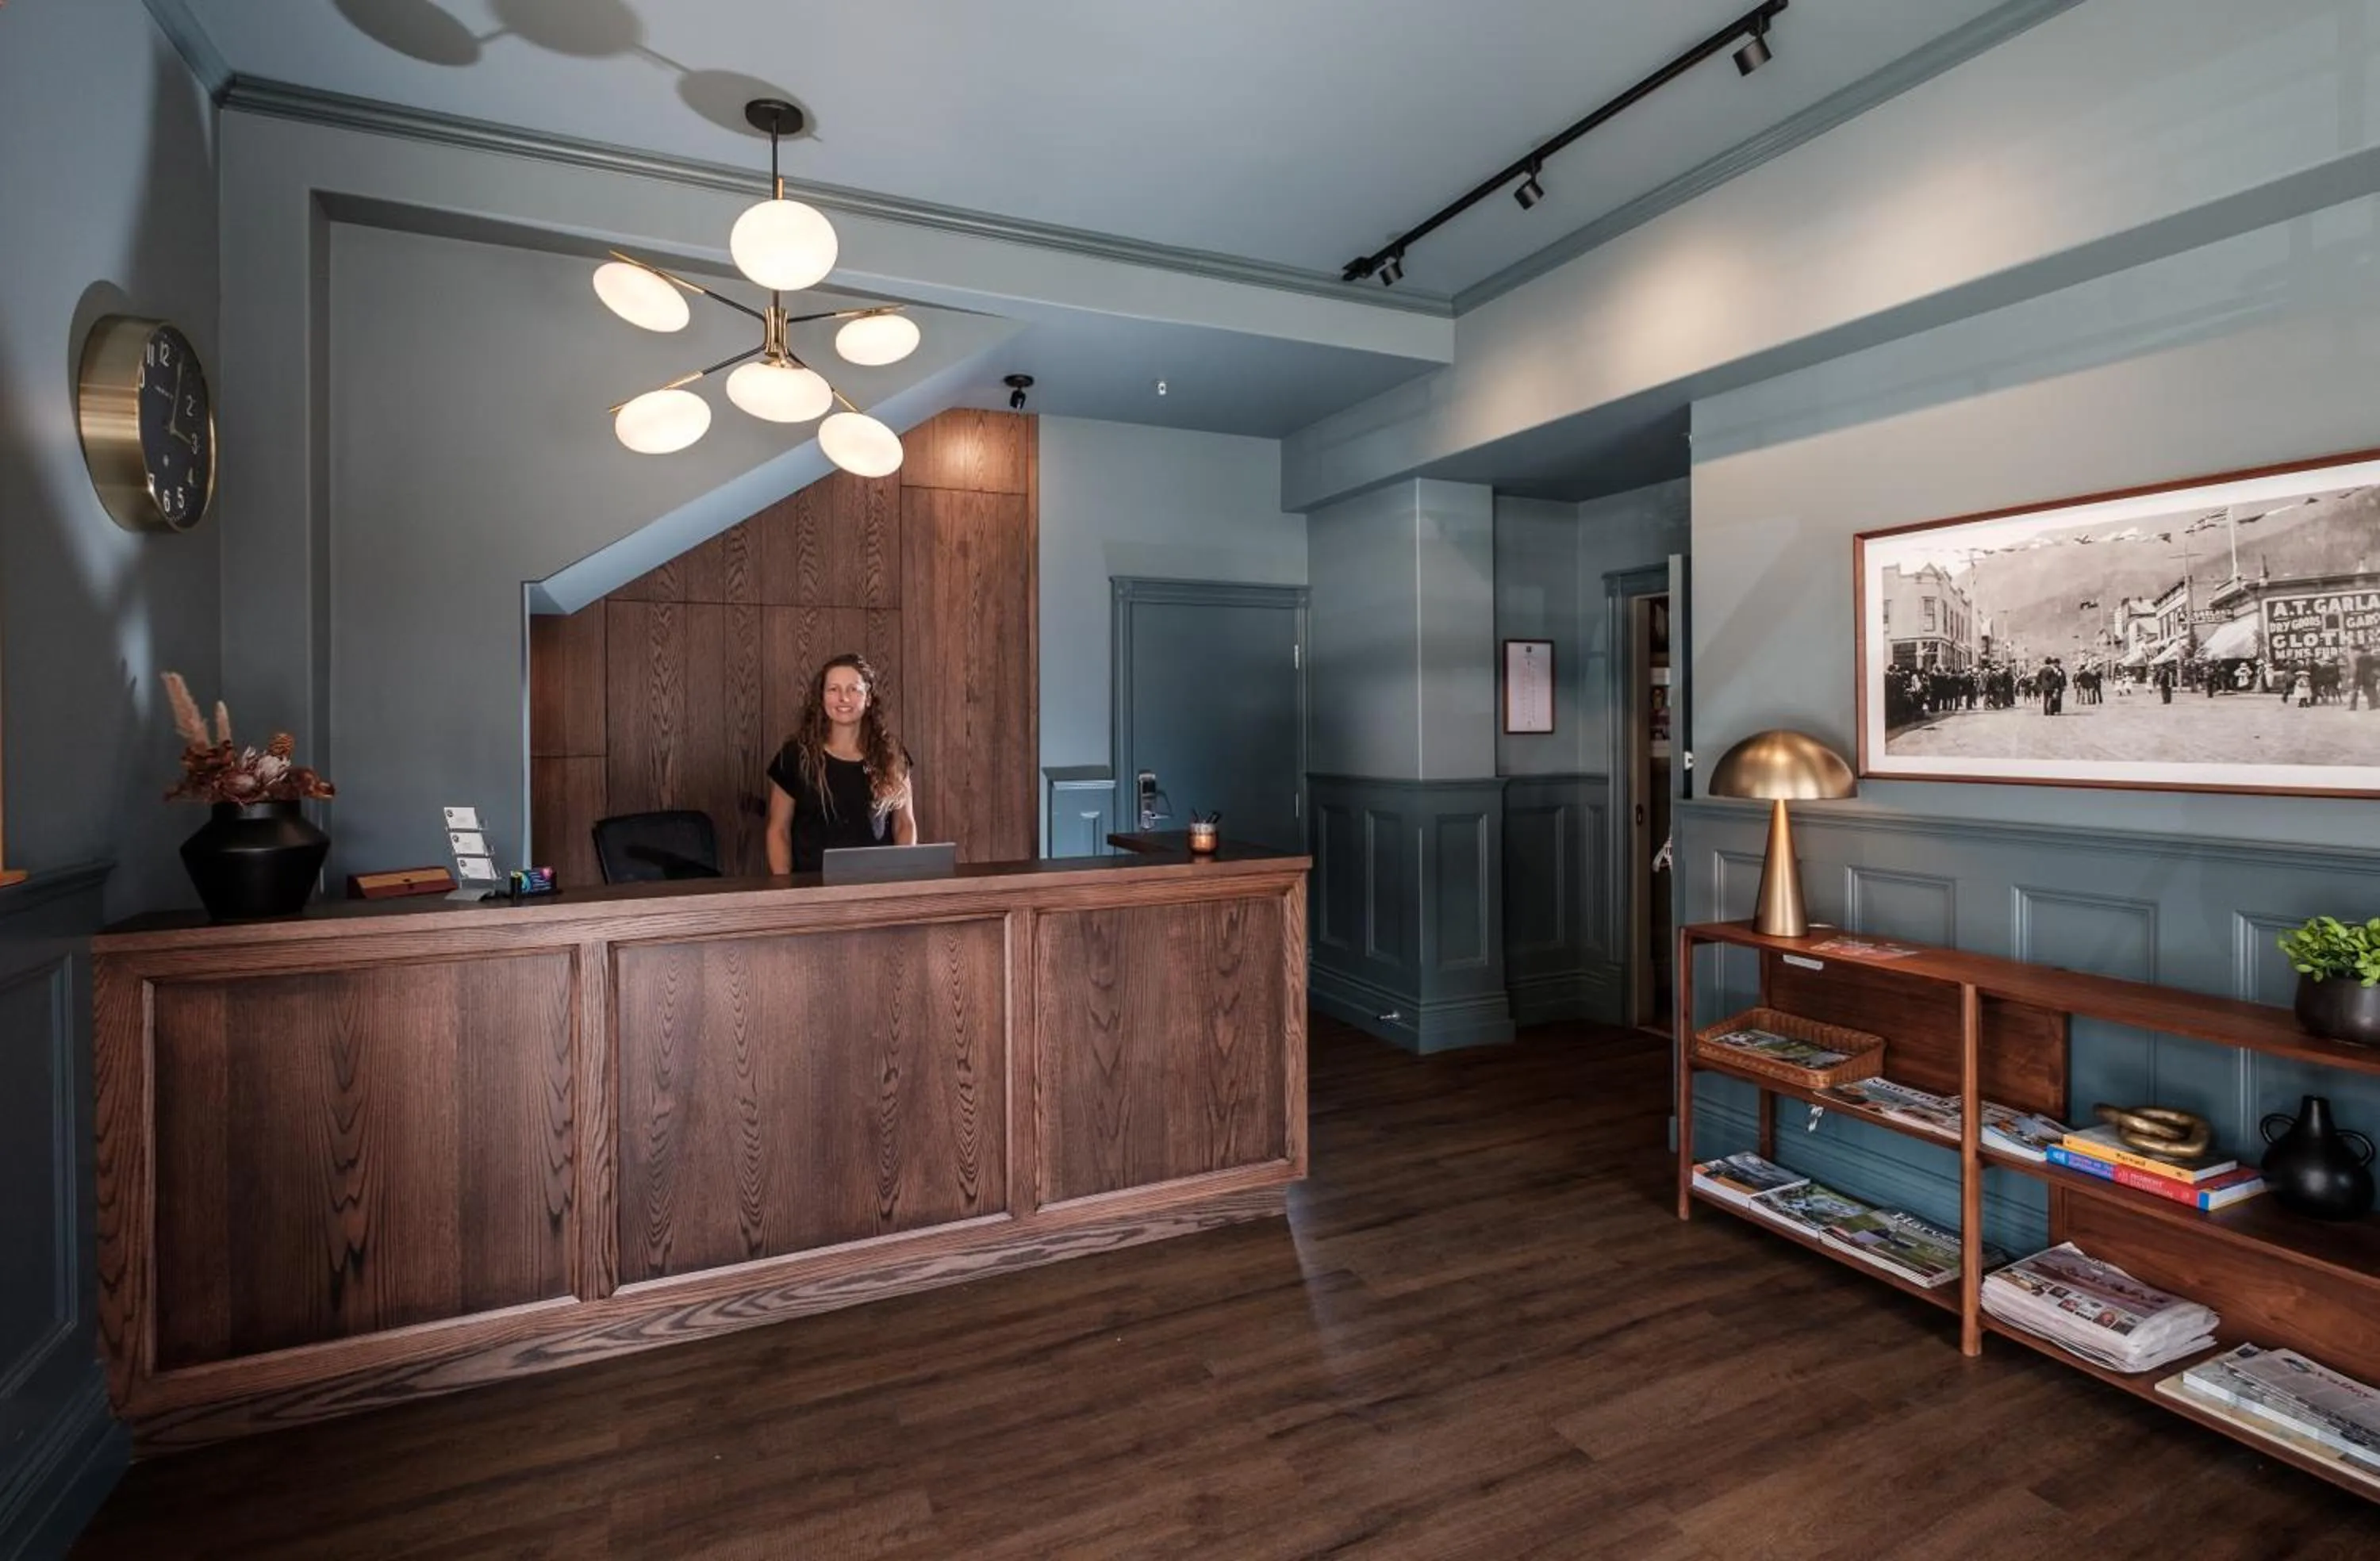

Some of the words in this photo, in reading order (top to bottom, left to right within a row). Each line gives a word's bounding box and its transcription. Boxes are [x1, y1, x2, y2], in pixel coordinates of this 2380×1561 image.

[147, 343, 155, 367] 11
[160, 341, 170, 367] 12
[186, 395, 194, 417] 2
[163, 489, 171, 512] 6
[177, 486, 185, 508] 5
[2270, 621, 2290, 634] DRY
